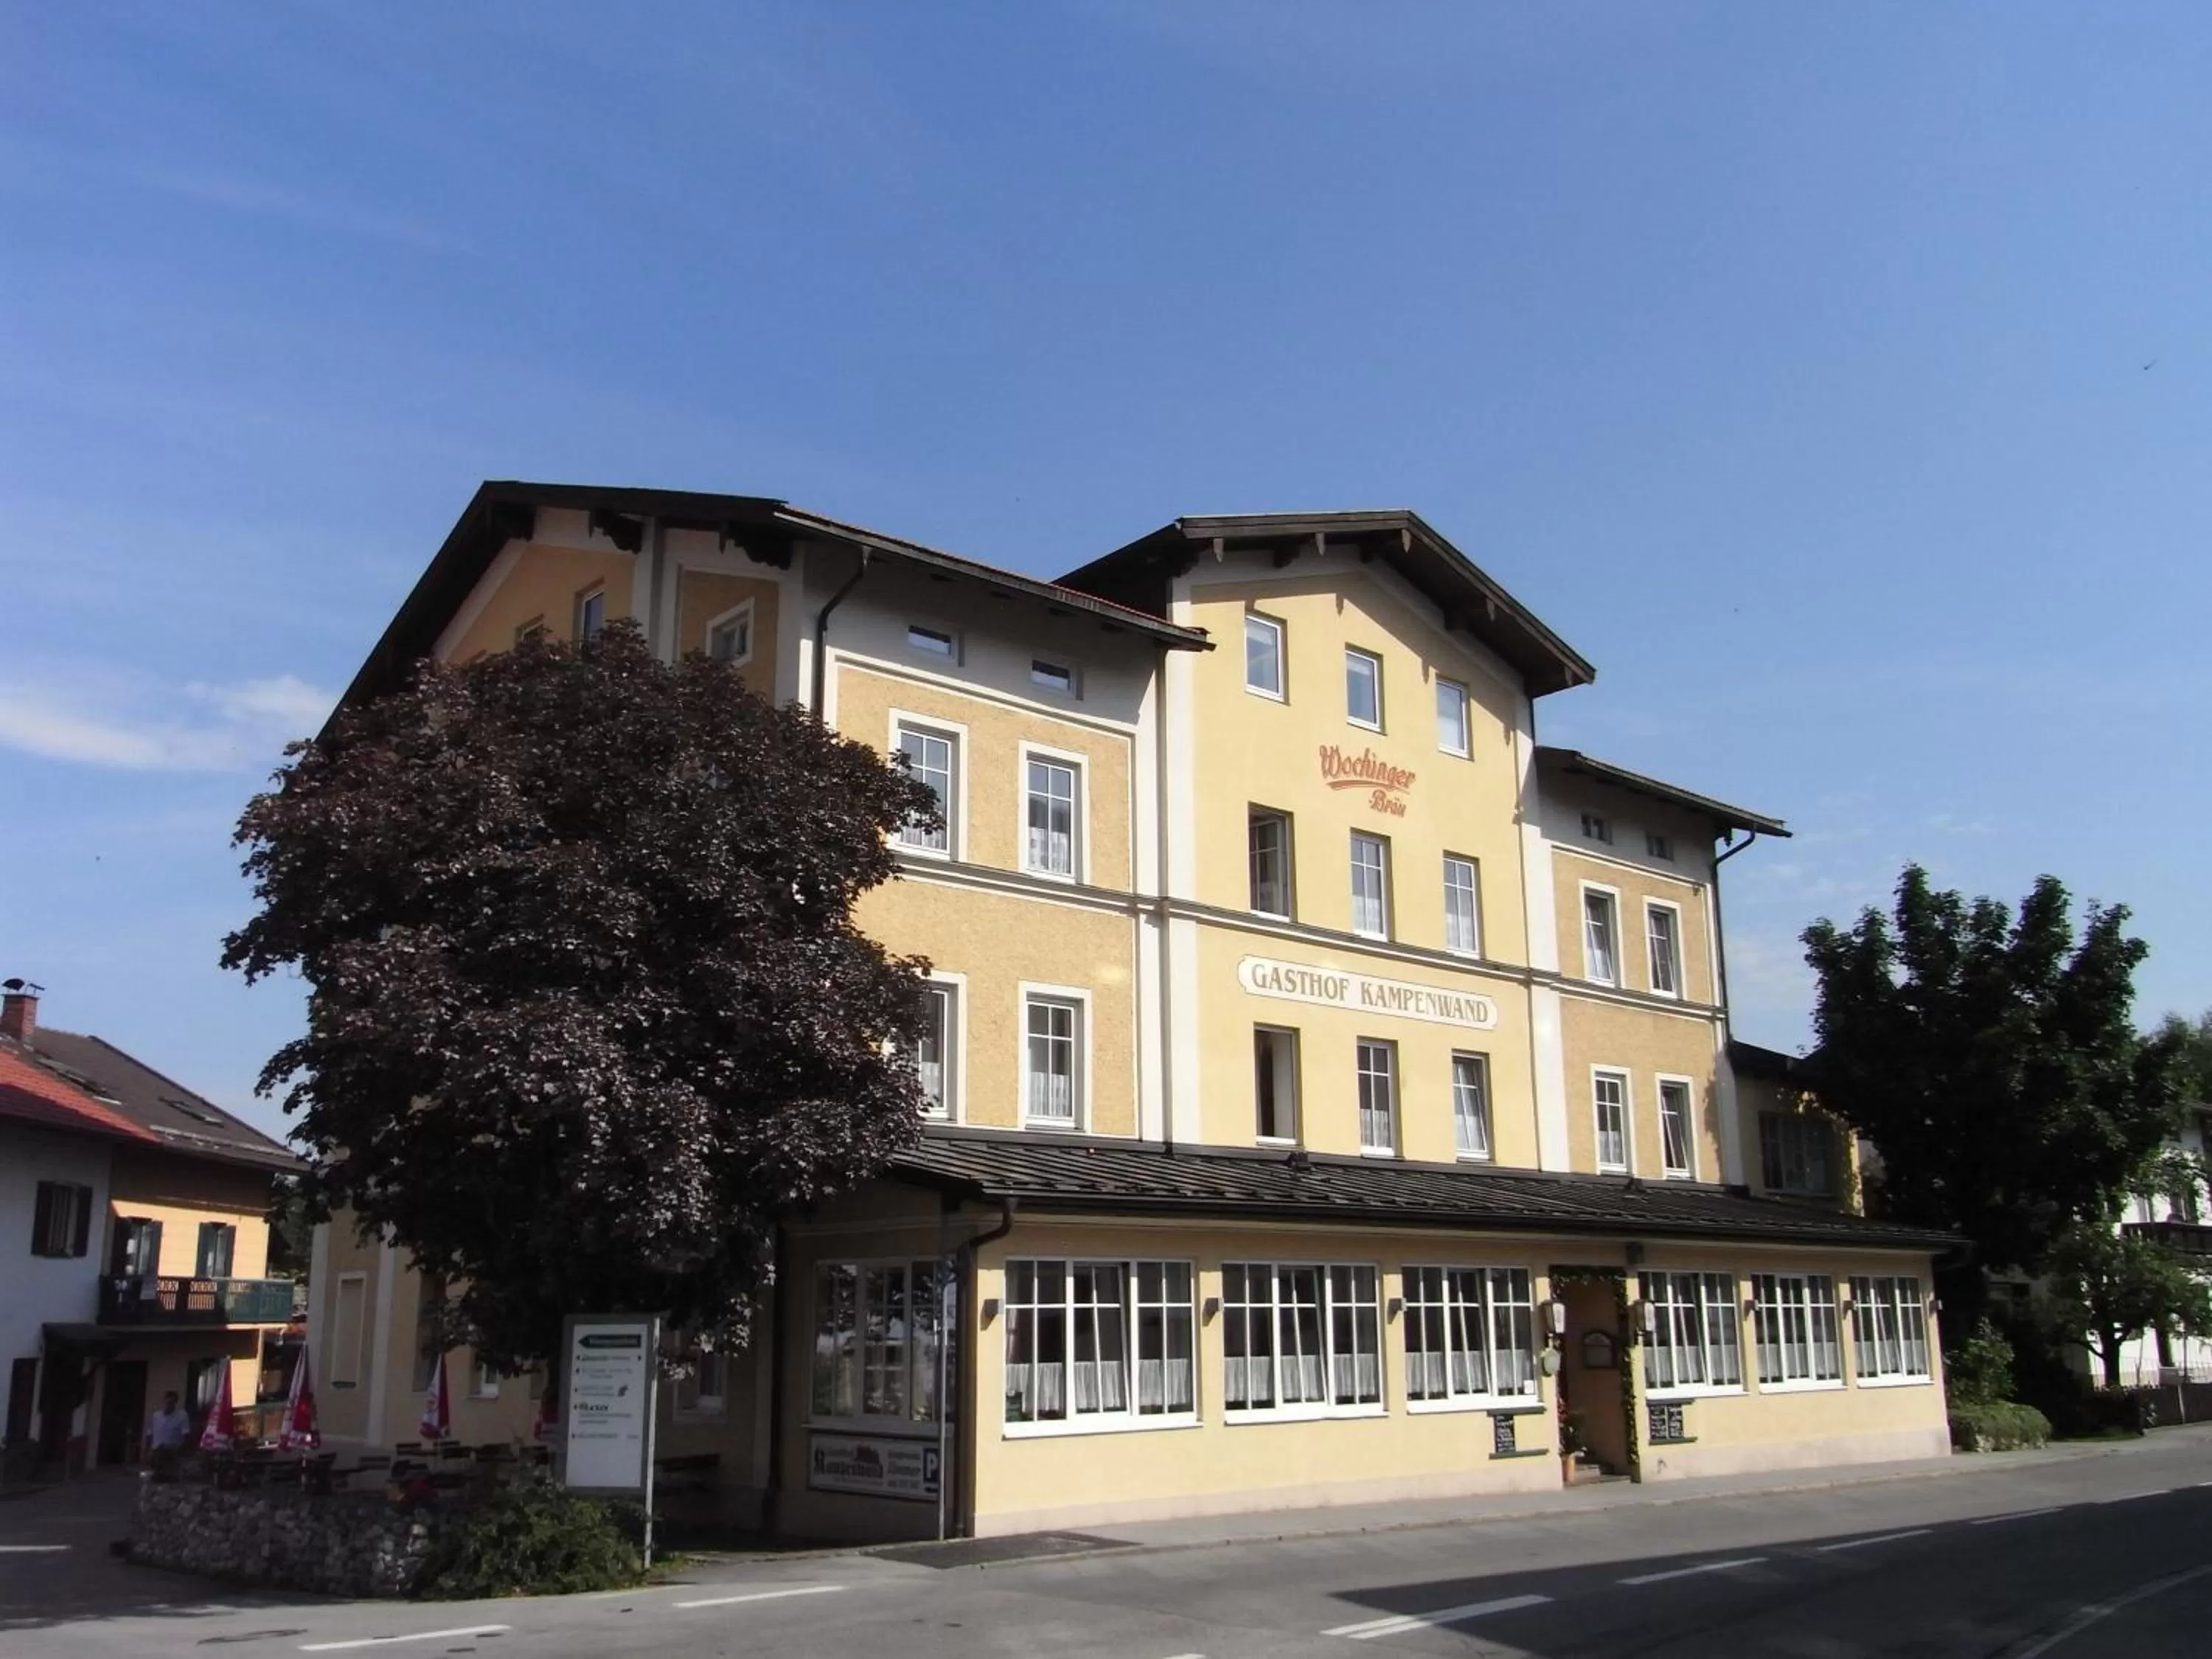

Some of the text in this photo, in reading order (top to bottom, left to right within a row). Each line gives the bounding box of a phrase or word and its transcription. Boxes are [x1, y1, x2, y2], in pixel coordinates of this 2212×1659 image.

[1319, 744, 1416, 788] Wochinger
[1251, 964, 1488, 1022] GASTHOF KAMPENWAND
